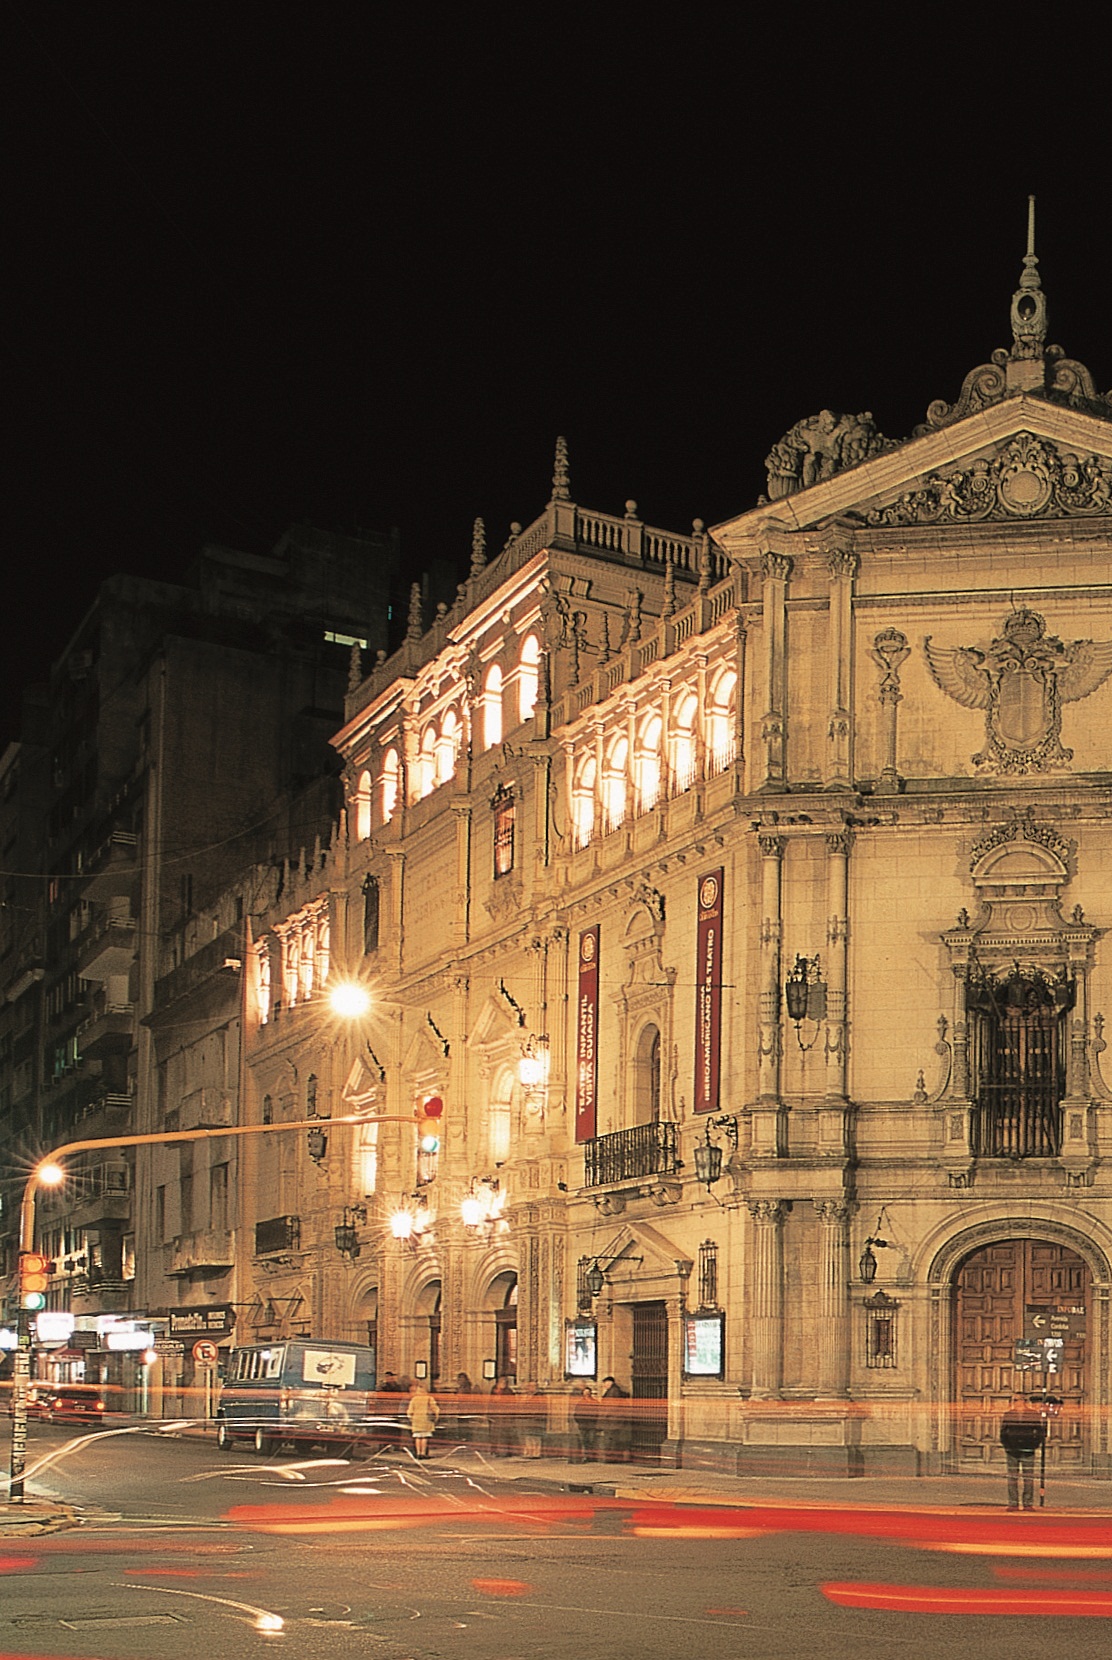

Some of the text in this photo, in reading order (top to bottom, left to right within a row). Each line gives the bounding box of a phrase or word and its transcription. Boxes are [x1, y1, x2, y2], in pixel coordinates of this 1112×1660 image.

[706, 928, 715, 975] TEATRO
[578, 994, 588, 1116] TEATRO INFANTIL
[585, 1002, 594, 1106] VISITA GUIADA
[703, 994, 712, 1102] IBEROAMERICANO
